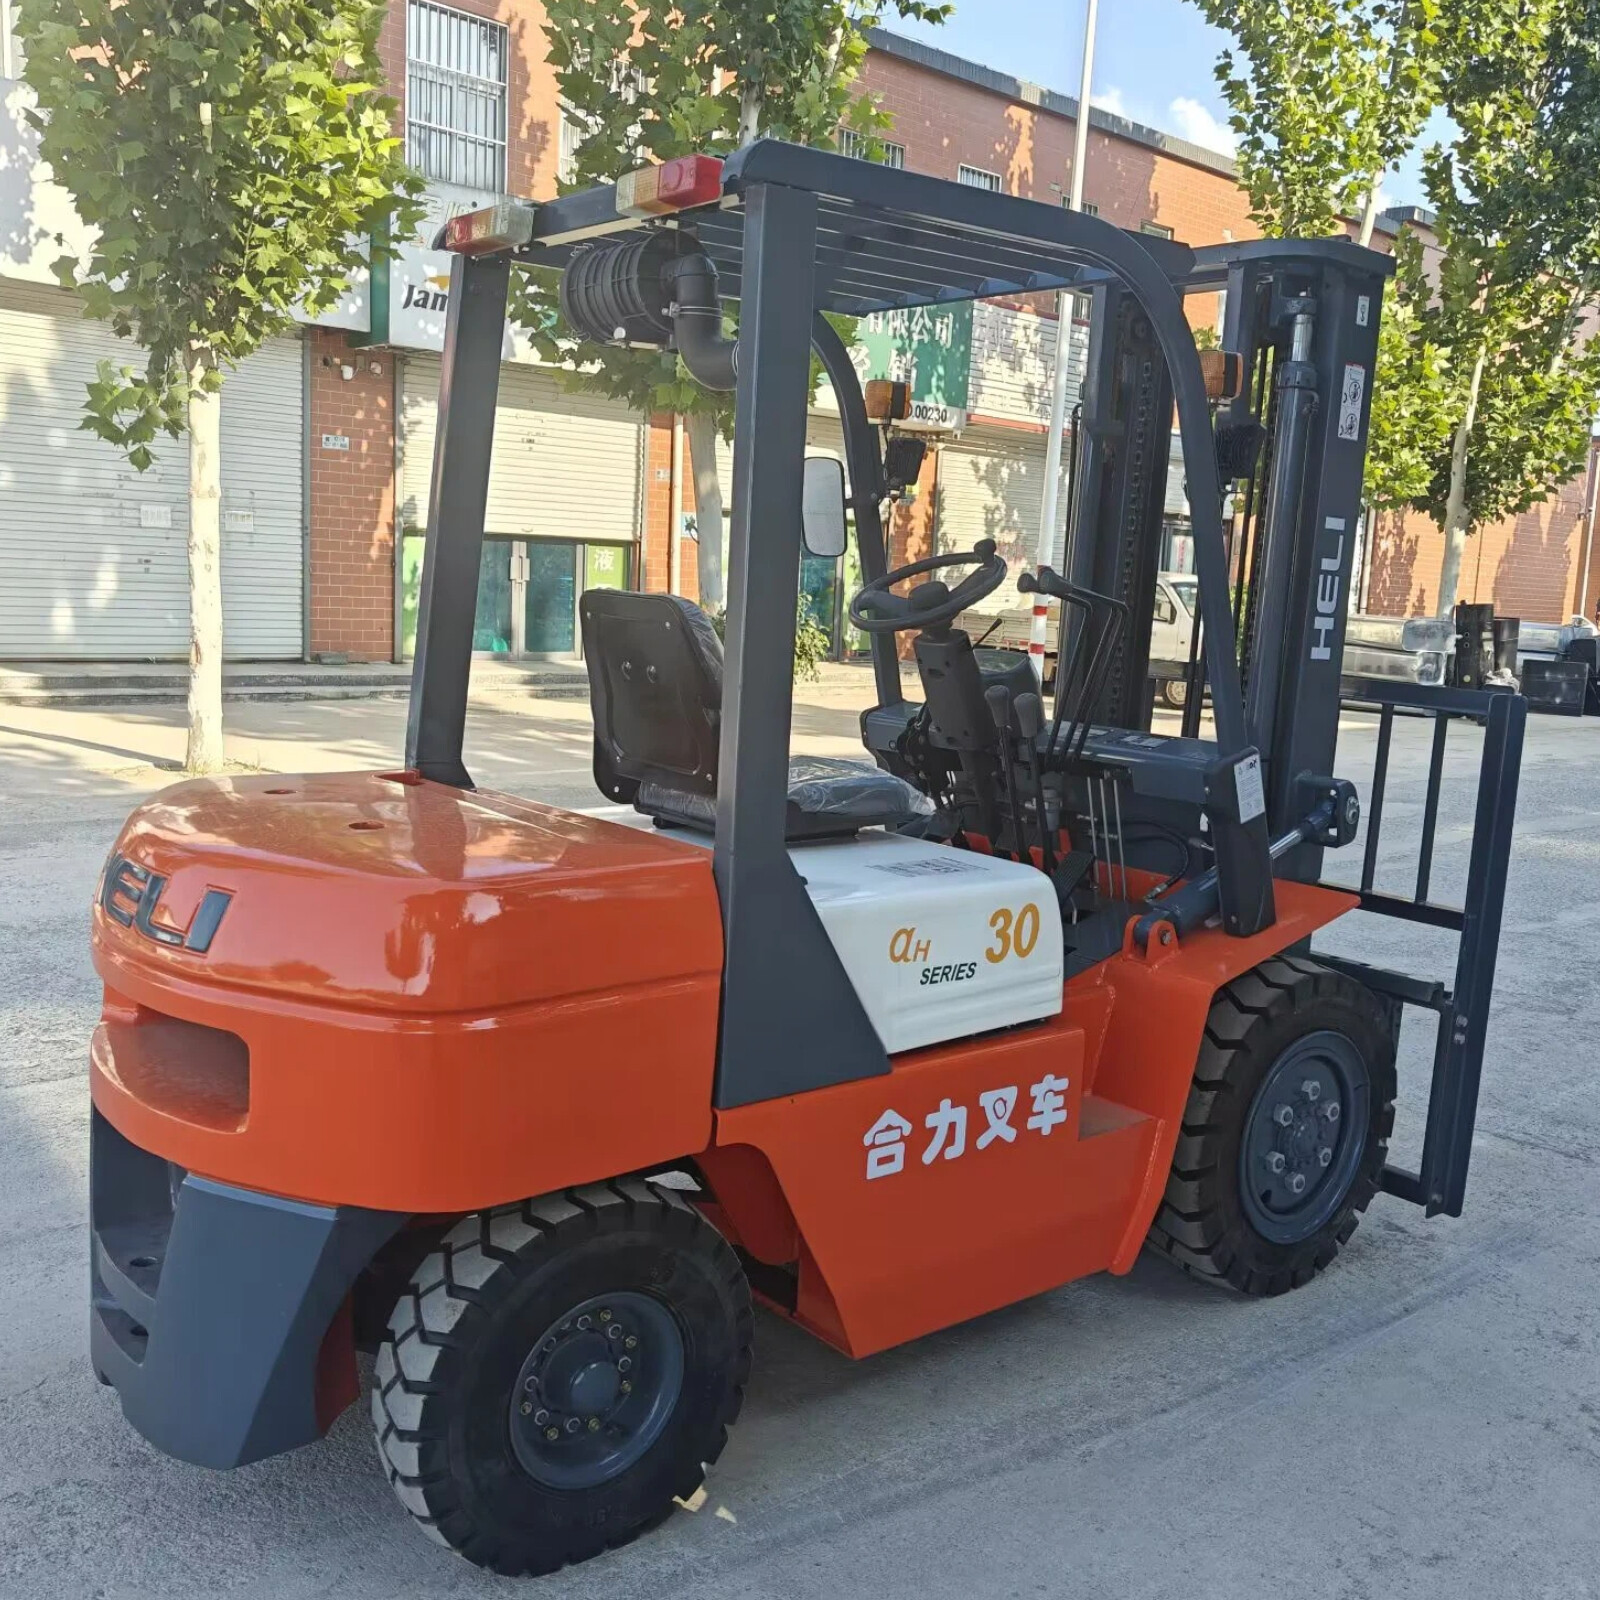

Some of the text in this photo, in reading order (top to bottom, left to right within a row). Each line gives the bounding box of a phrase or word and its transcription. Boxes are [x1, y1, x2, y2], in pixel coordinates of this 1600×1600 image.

[1310, 516, 1346, 660] HELI
[920, 962, 977, 985] SERIES
[985, 903, 1040, 964] 30
[863, 1074, 1069, 1180] 合力叉车
